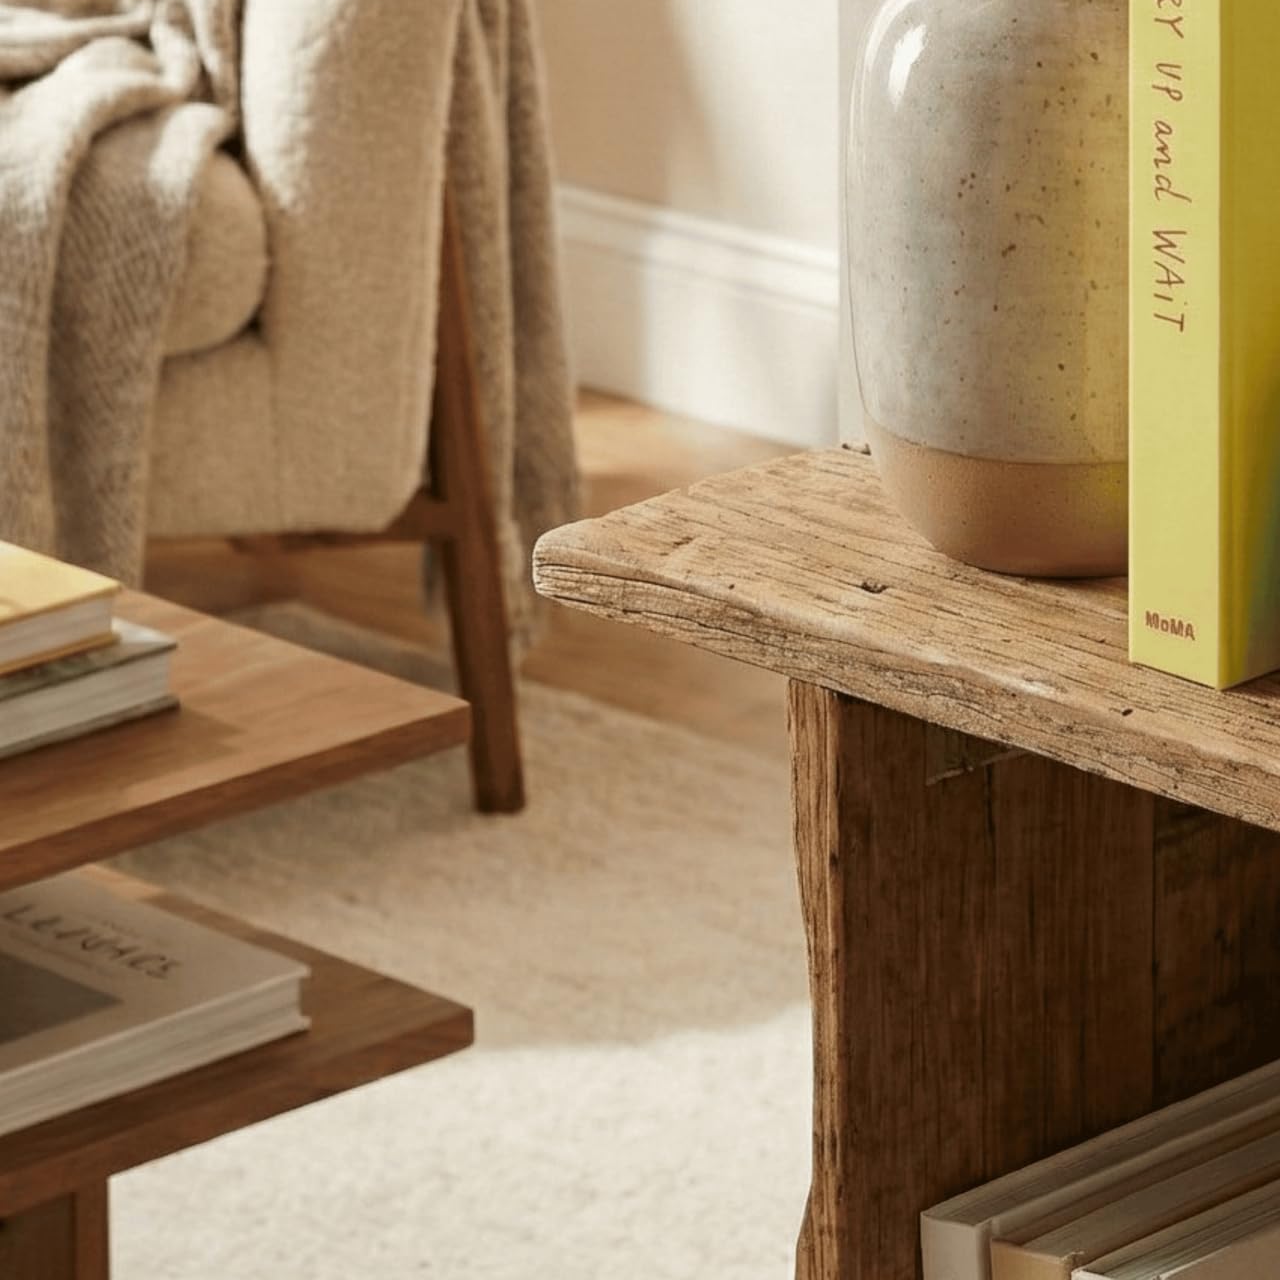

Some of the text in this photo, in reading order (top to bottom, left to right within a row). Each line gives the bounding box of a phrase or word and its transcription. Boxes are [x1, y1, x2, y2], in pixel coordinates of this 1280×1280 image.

[1151, 62, 1183, 102] UP
[1153, 120, 1192, 203] and
[1145, 610, 1196, 641] MoMA
